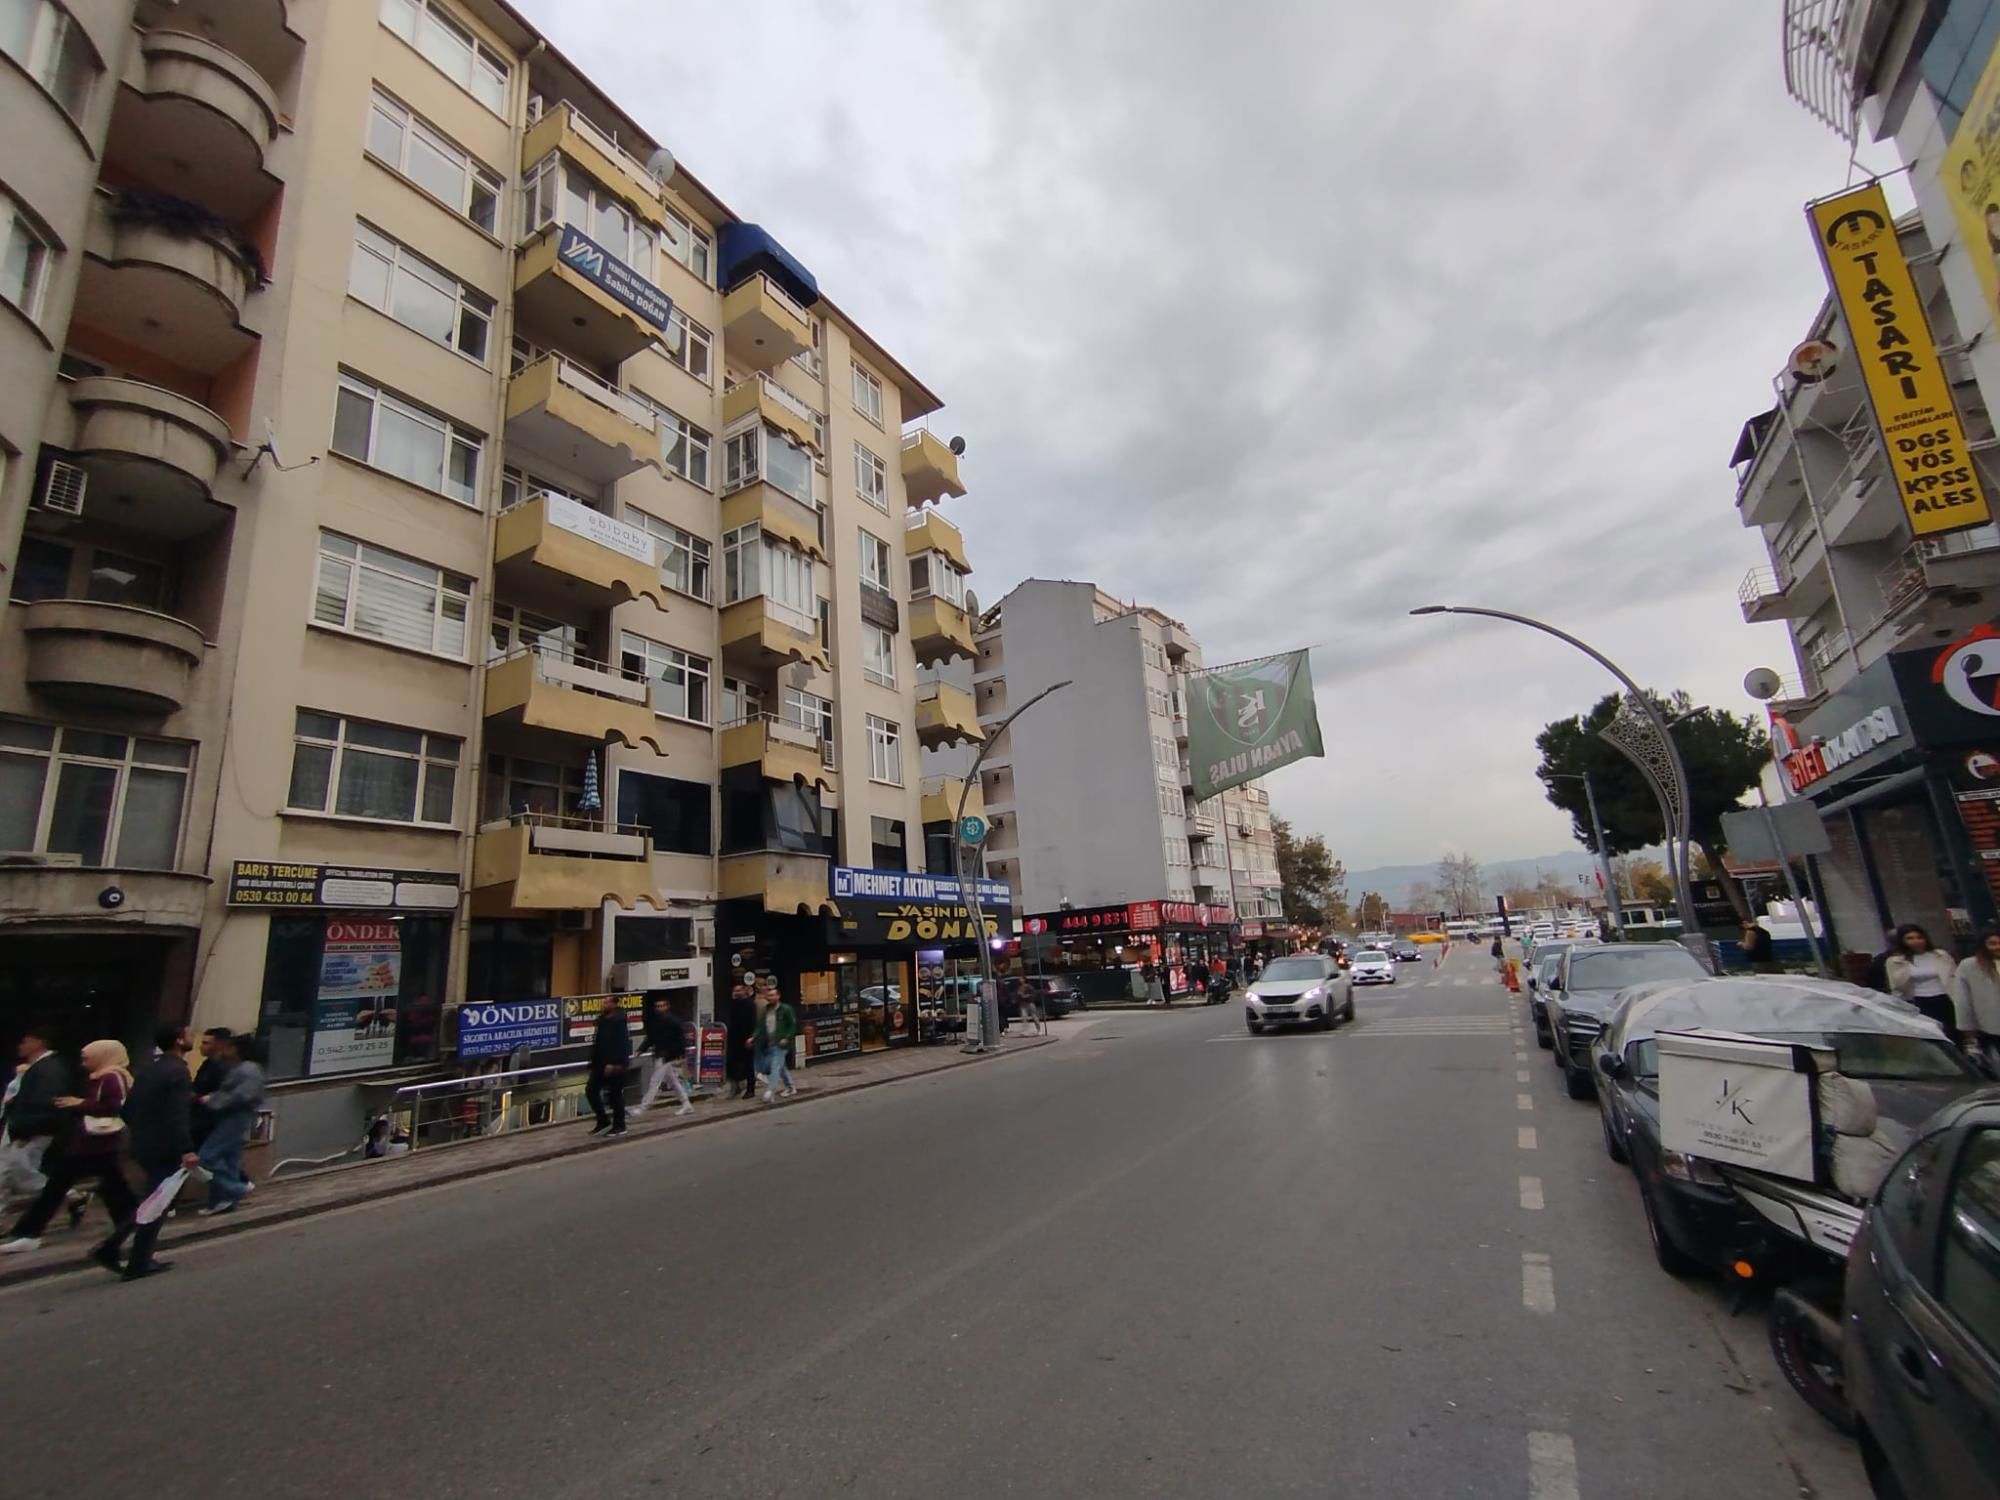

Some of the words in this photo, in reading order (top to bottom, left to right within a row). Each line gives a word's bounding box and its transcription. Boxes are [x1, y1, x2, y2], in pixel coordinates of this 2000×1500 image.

[636, 295, 665, 322] DOĞAN
[1853, 251, 1921, 400] TASARI
[1896, 428, 1951, 453] DGS
[1904, 448, 1955, 472] YÖS
[1904, 467, 1970, 495] KPSS
[1913, 488, 1977, 515] ALES
[237, 863, 269, 879] BARIŞ
[272, 864, 319, 880] TERCÜME
[236, 890, 262, 903] 0530
[264, 890, 283, 903] 433
[286, 892, 298, 903] 00
[854, 873, 901, 896] MEHMET
[903, 877, 935, 898] AKTAN
[898, 904, 950, 918] YASİN
[1062, 914, 1088, 929] 444
[1093, 913, 1101, 927] 9
[1103, 910, 1128, 926] 831
[326, 921, 400, 940] ÖNDER
[482, 1003, 560, 1025] ÖNDER
